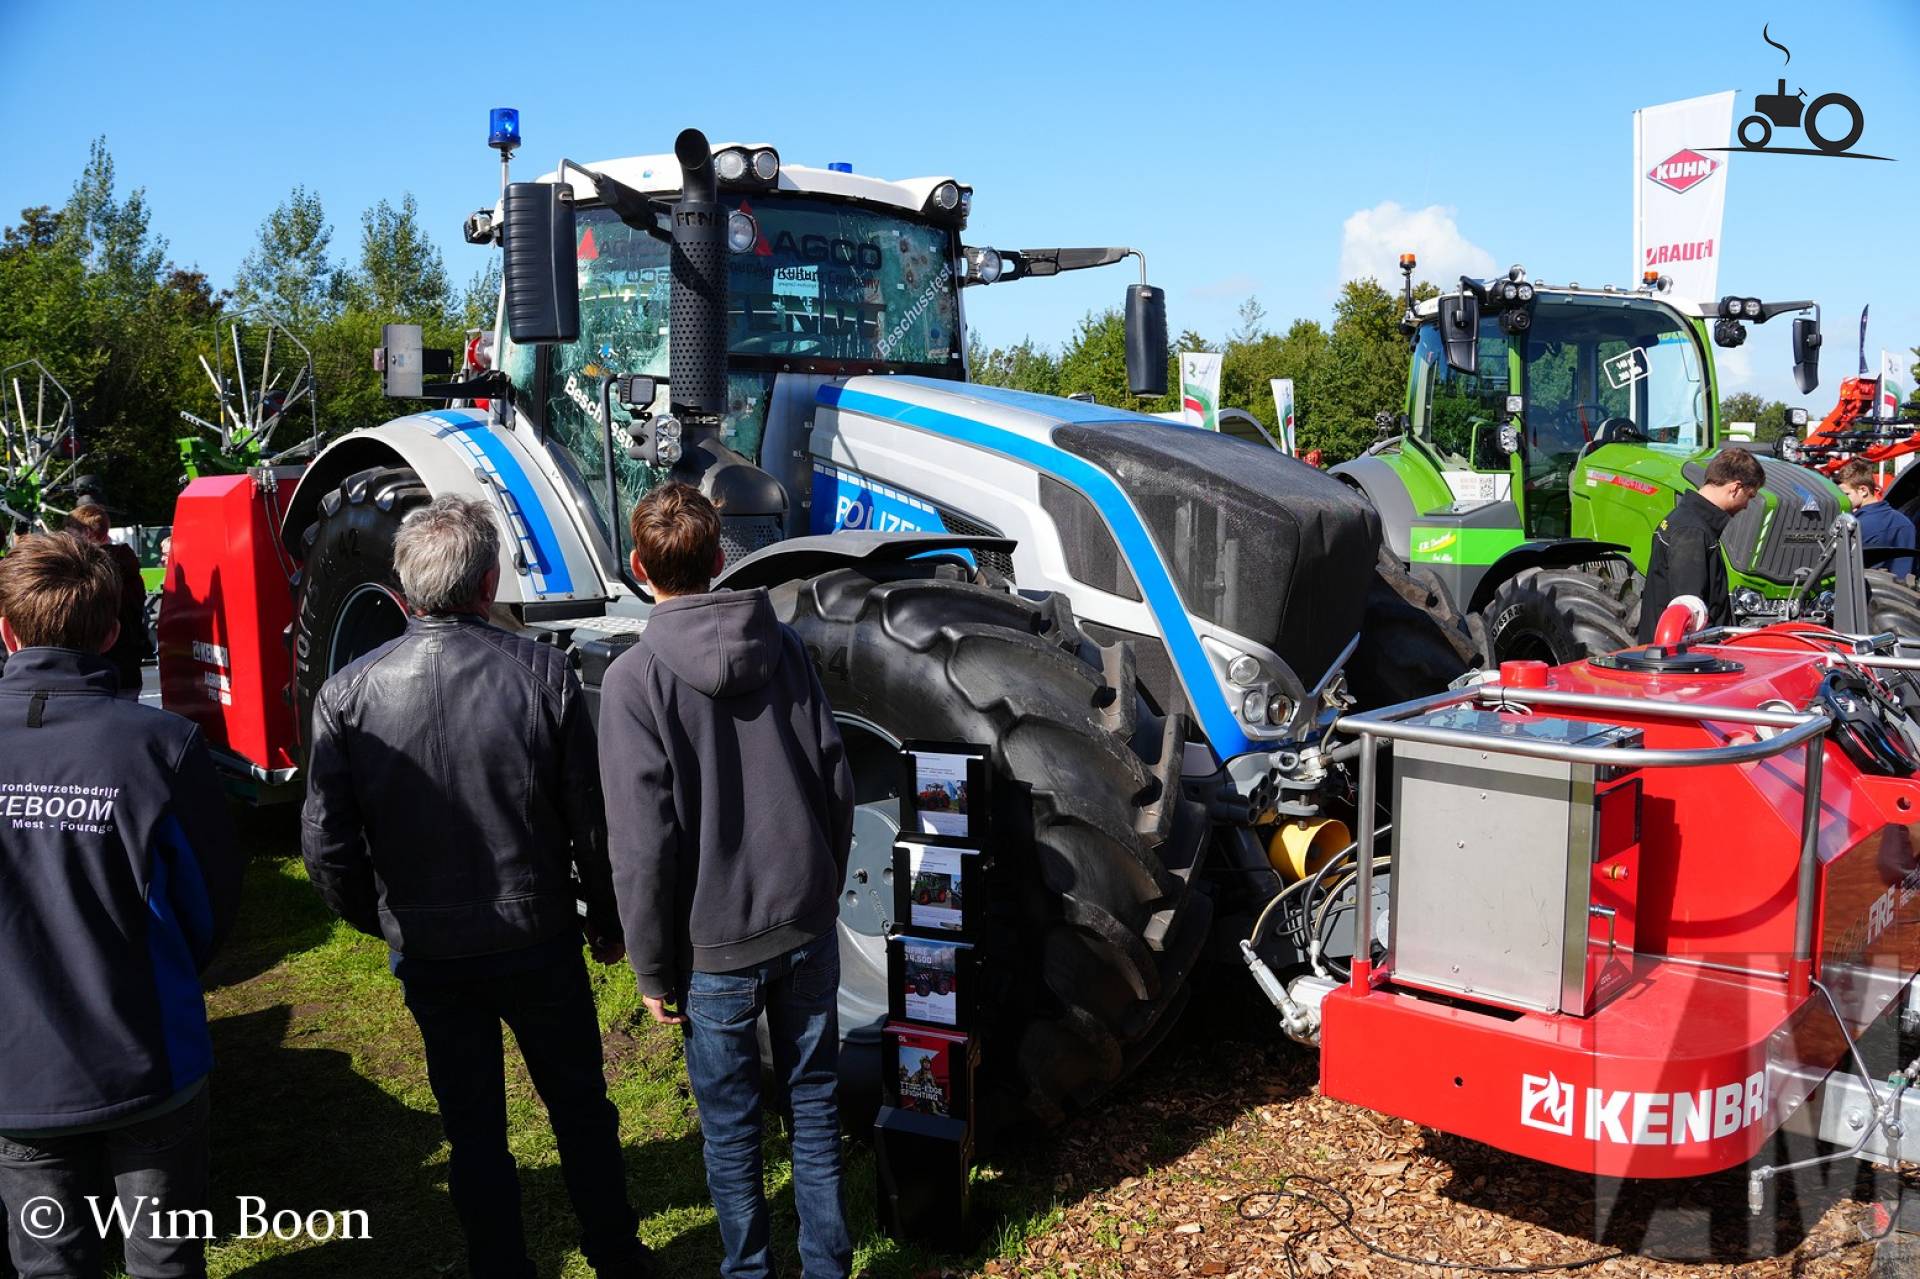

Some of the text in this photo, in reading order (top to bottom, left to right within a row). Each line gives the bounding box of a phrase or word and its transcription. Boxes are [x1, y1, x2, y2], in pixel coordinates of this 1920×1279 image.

[1656, 159, 1711, 180] KUHN
[773, 230, 882, 271] AGCO
[1658, 239, 1713, 264] RAUCH
[877, 262, 953, 357] Beschusstest
[836, 495, 922, 532] POLIZE
[0, 782, 120, 800] rondverzetbedrijf
[12, 819, 44, 830] Mest
[60, 821, 114, 834] Fourage
